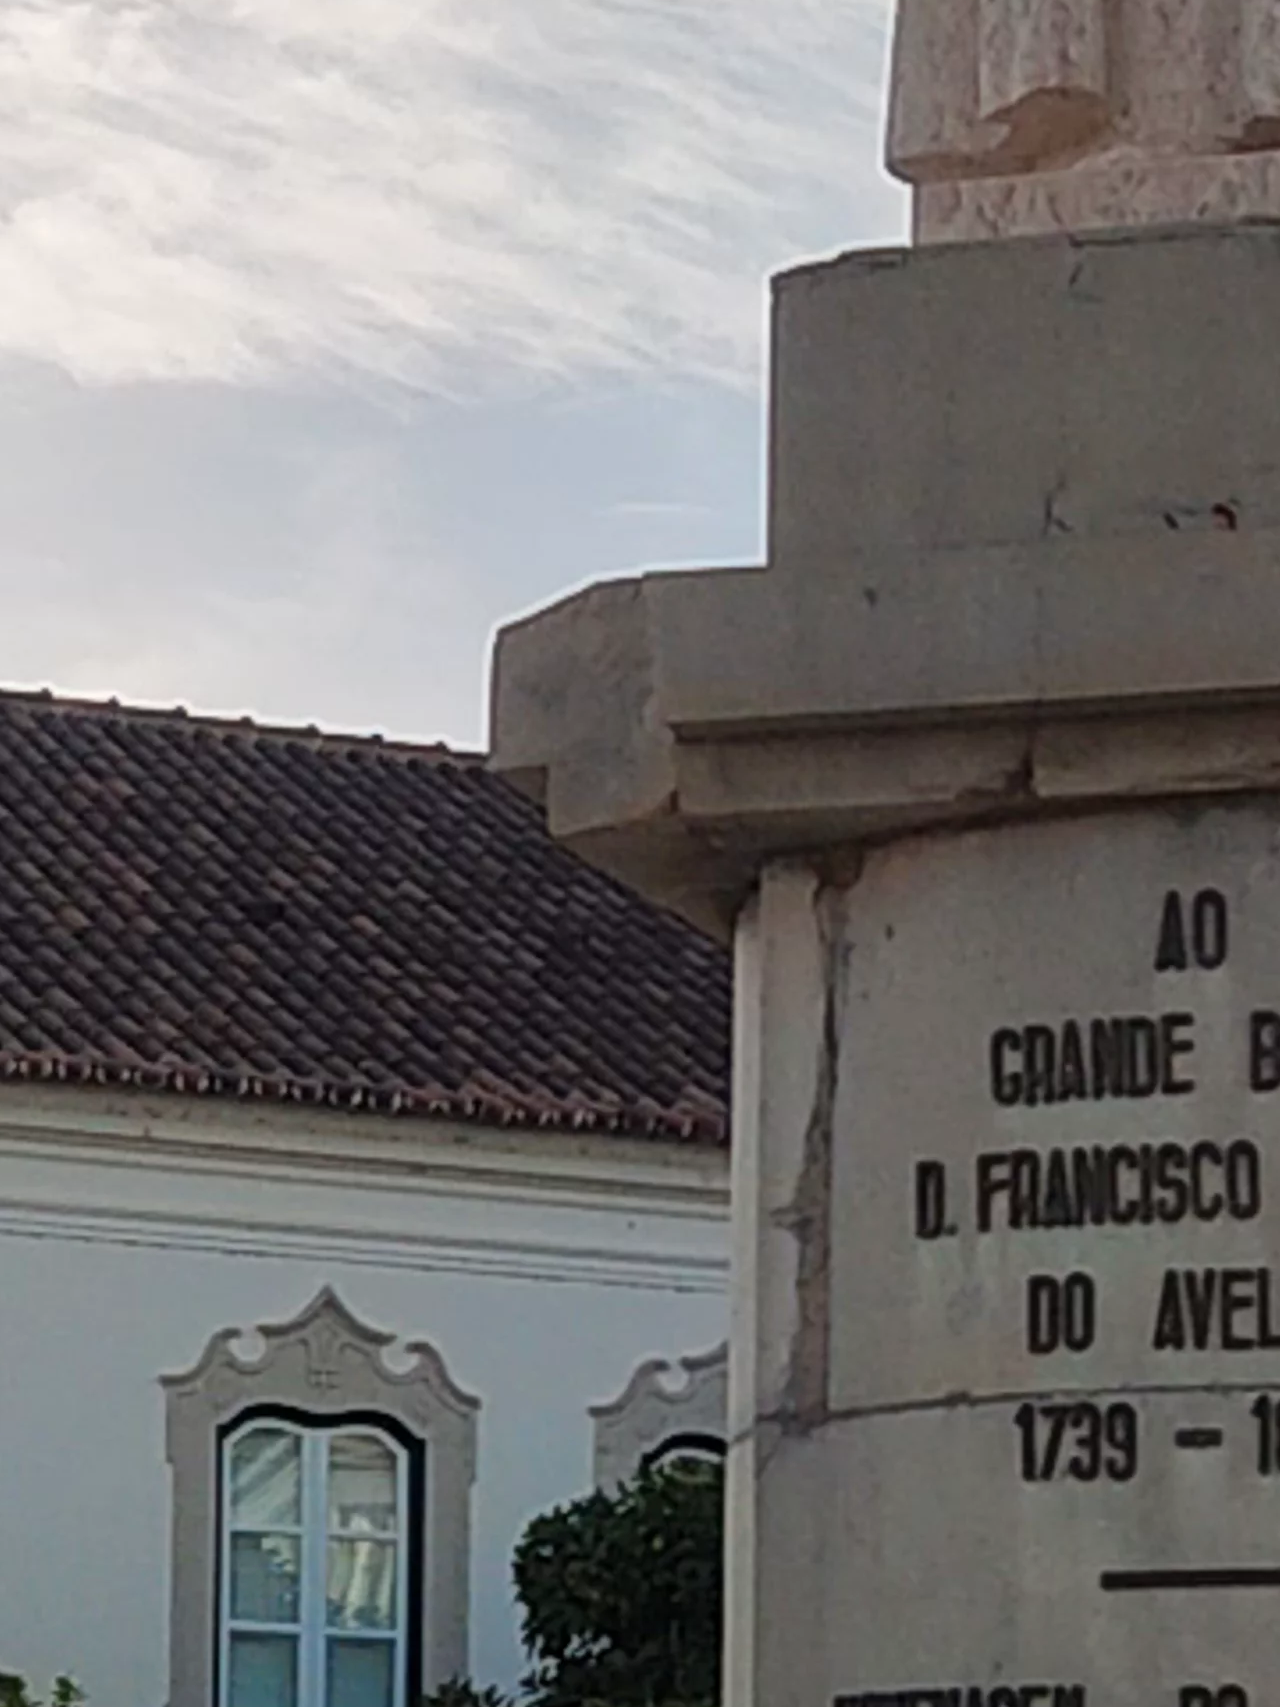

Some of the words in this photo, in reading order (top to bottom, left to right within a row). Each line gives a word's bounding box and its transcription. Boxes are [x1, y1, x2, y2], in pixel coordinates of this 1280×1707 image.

[1154, 889, 1227, 972] AO
[991, 1013, 1194, 1107] GRANDE
[916, 1161, 958, 1239] D.
[977, 1140, 1260, 1233] FRANCISCO
[1028, 1272, 1094, 1354] DO
[1014, 1401, 1137, 1481] 1739
